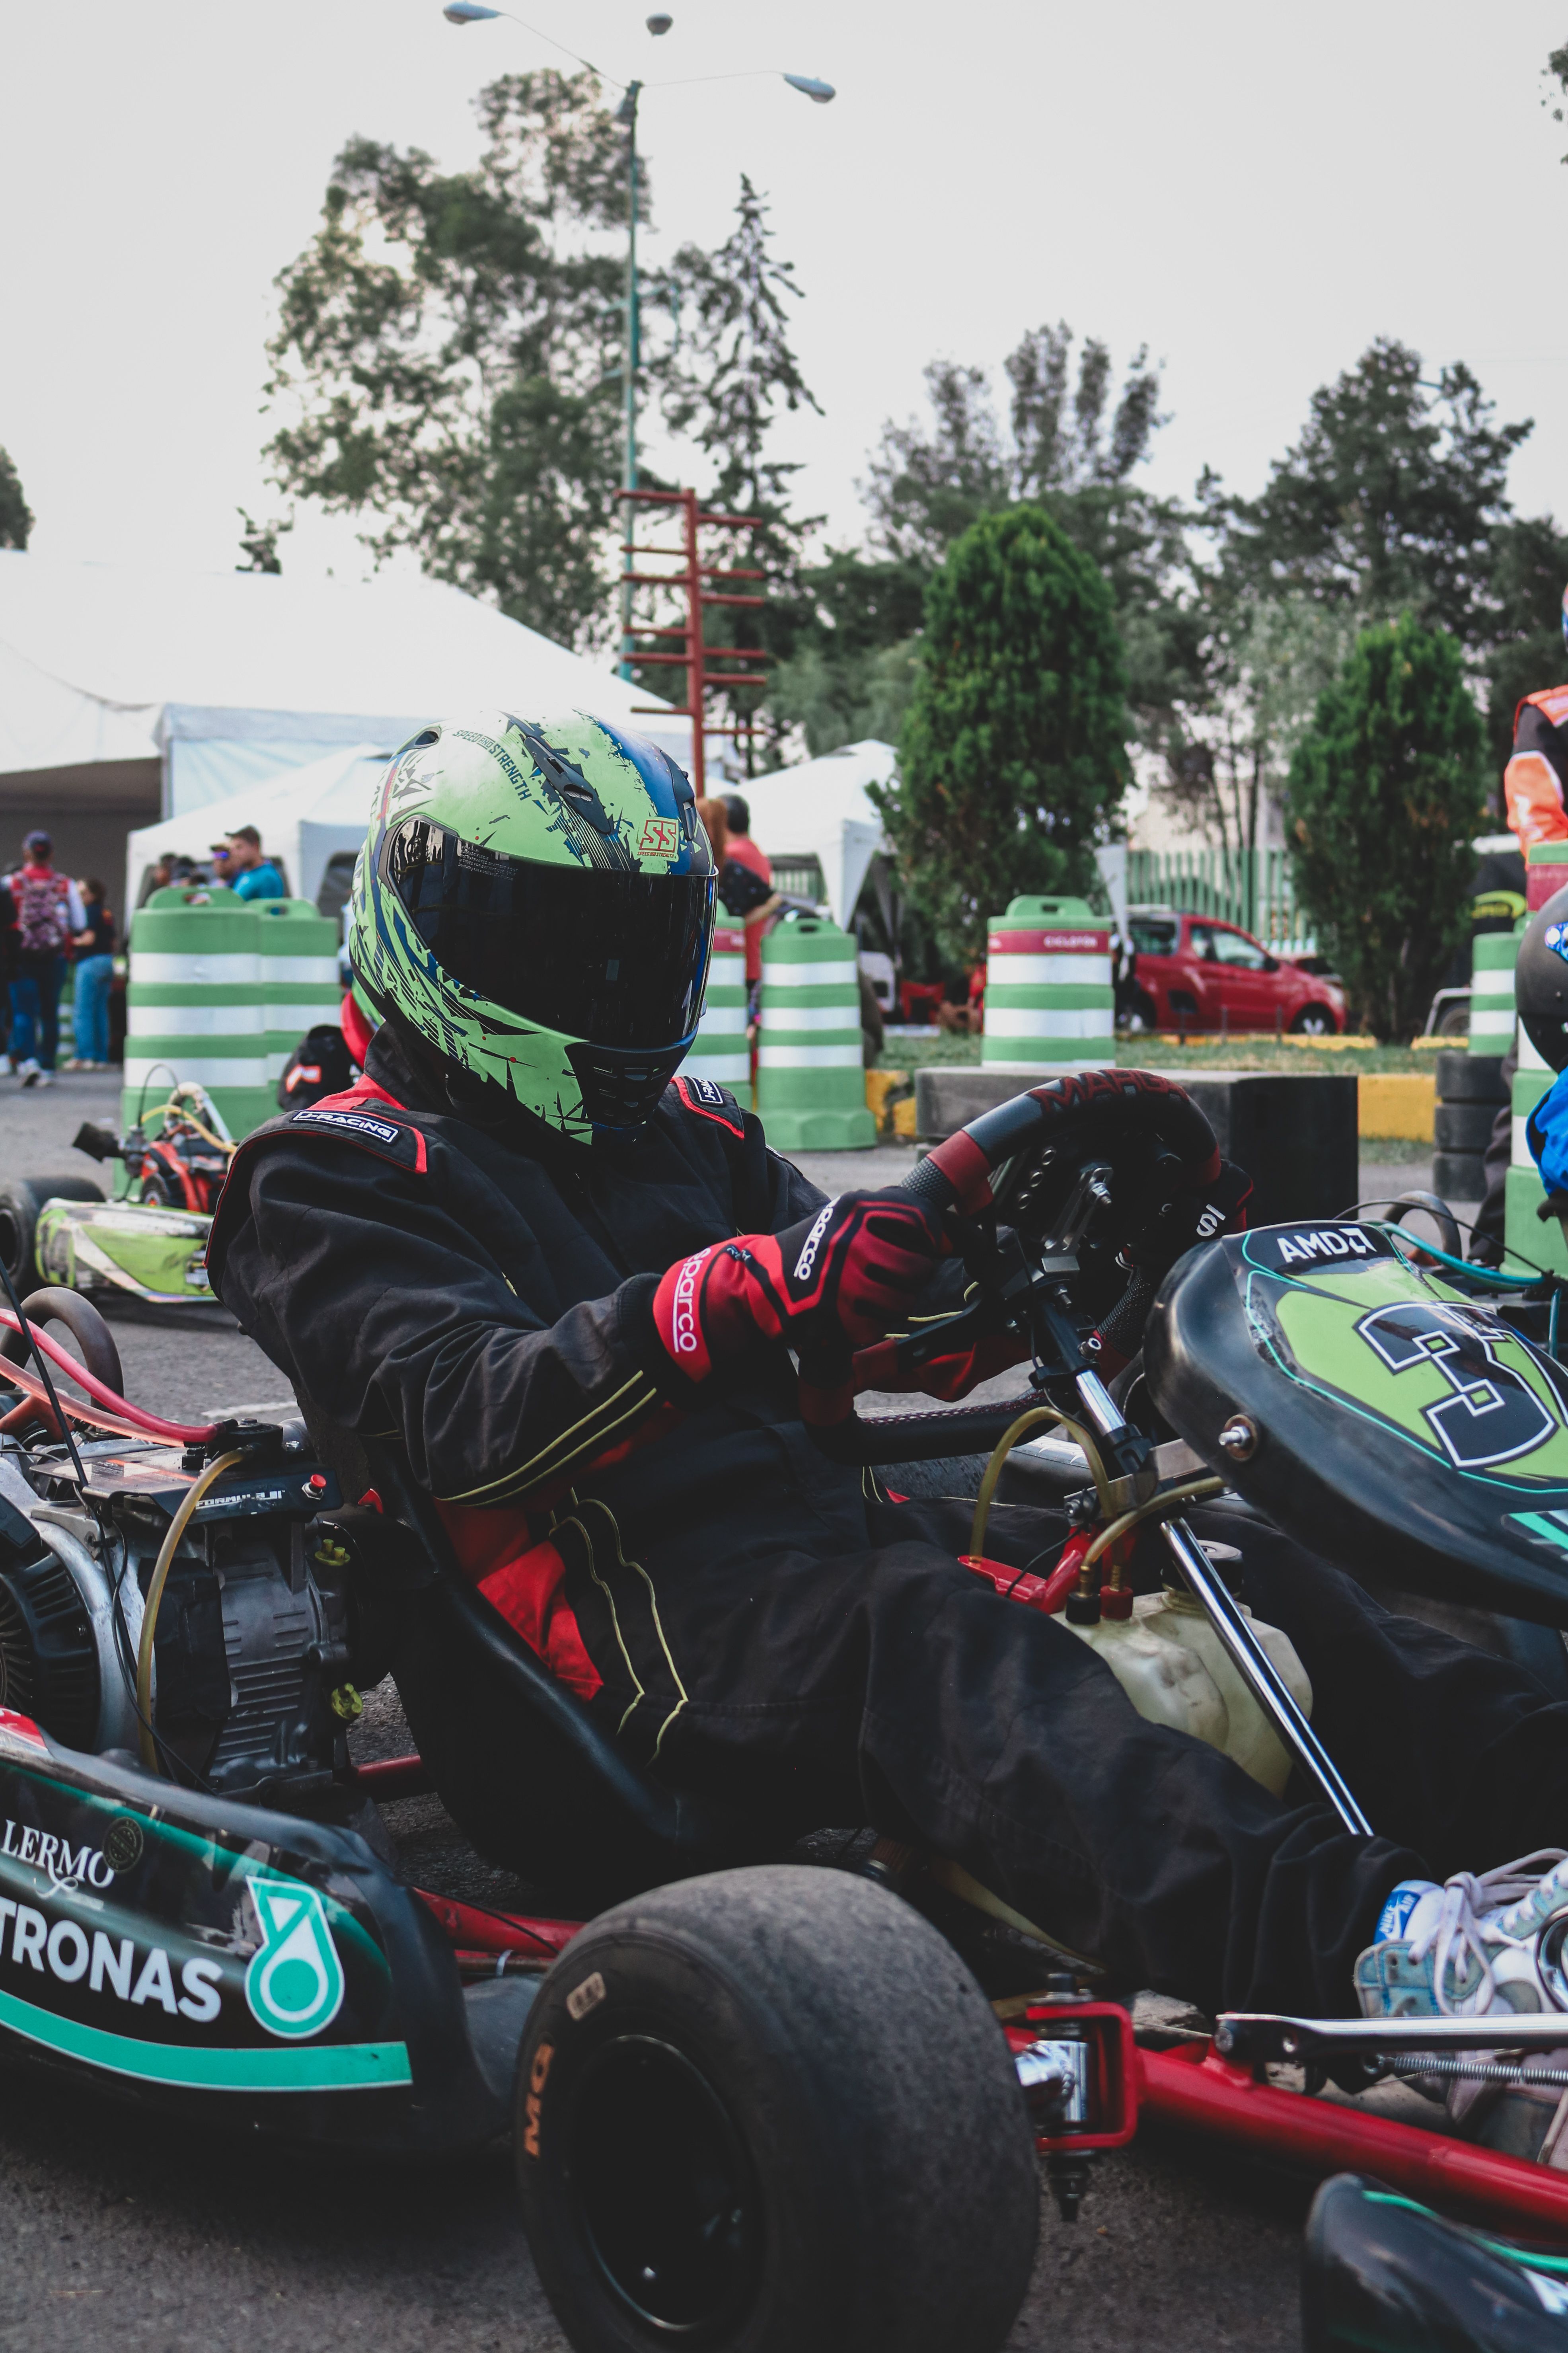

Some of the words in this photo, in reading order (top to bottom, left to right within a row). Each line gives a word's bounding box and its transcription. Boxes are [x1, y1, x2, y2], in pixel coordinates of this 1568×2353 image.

[452, 730, 483, 743] SPEED
[478, 737, 495, 749] AND
[489, 743, 532, 801] STRENGTH
[639, 820, 676, 853] SS
[1277, 1231, 1349, 1263] AMD
[672, 1247, 711, 1353] sparco
[1356, 1302, 1558, 1468] 3
[0, 1819, 115, 1900] LERMO
[1378, 1904, 1394, 1934] NIKE
[1400, 1893, 1416, 1914] AIR
